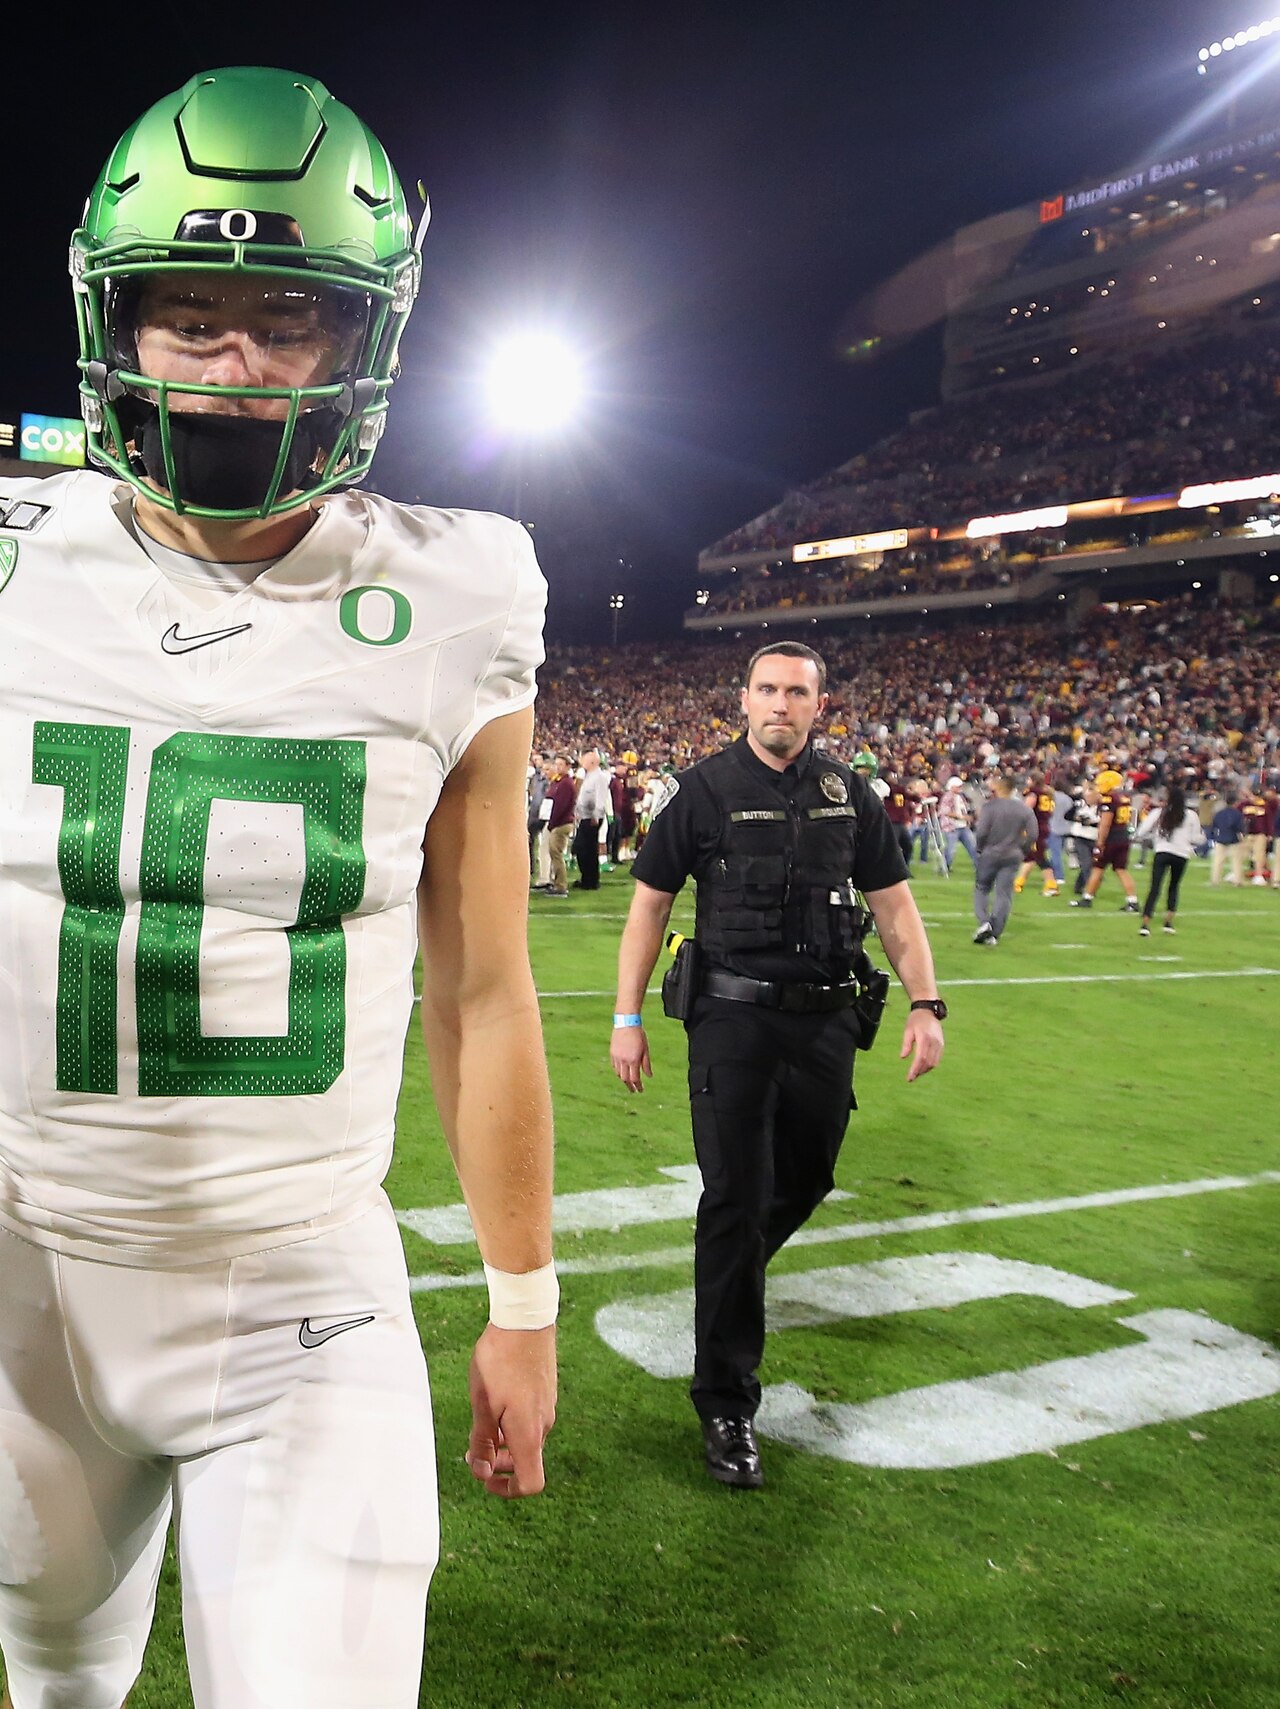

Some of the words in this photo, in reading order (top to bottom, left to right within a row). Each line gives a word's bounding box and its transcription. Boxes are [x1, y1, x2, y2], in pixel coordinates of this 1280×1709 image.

[220, 209, 257, 240] O
[22, 425, 85, 454] COX
[339, 585, 412, 646] O
[742, 811, 774, 820] BUTTON
[32, 720, 368, 1097] 10
